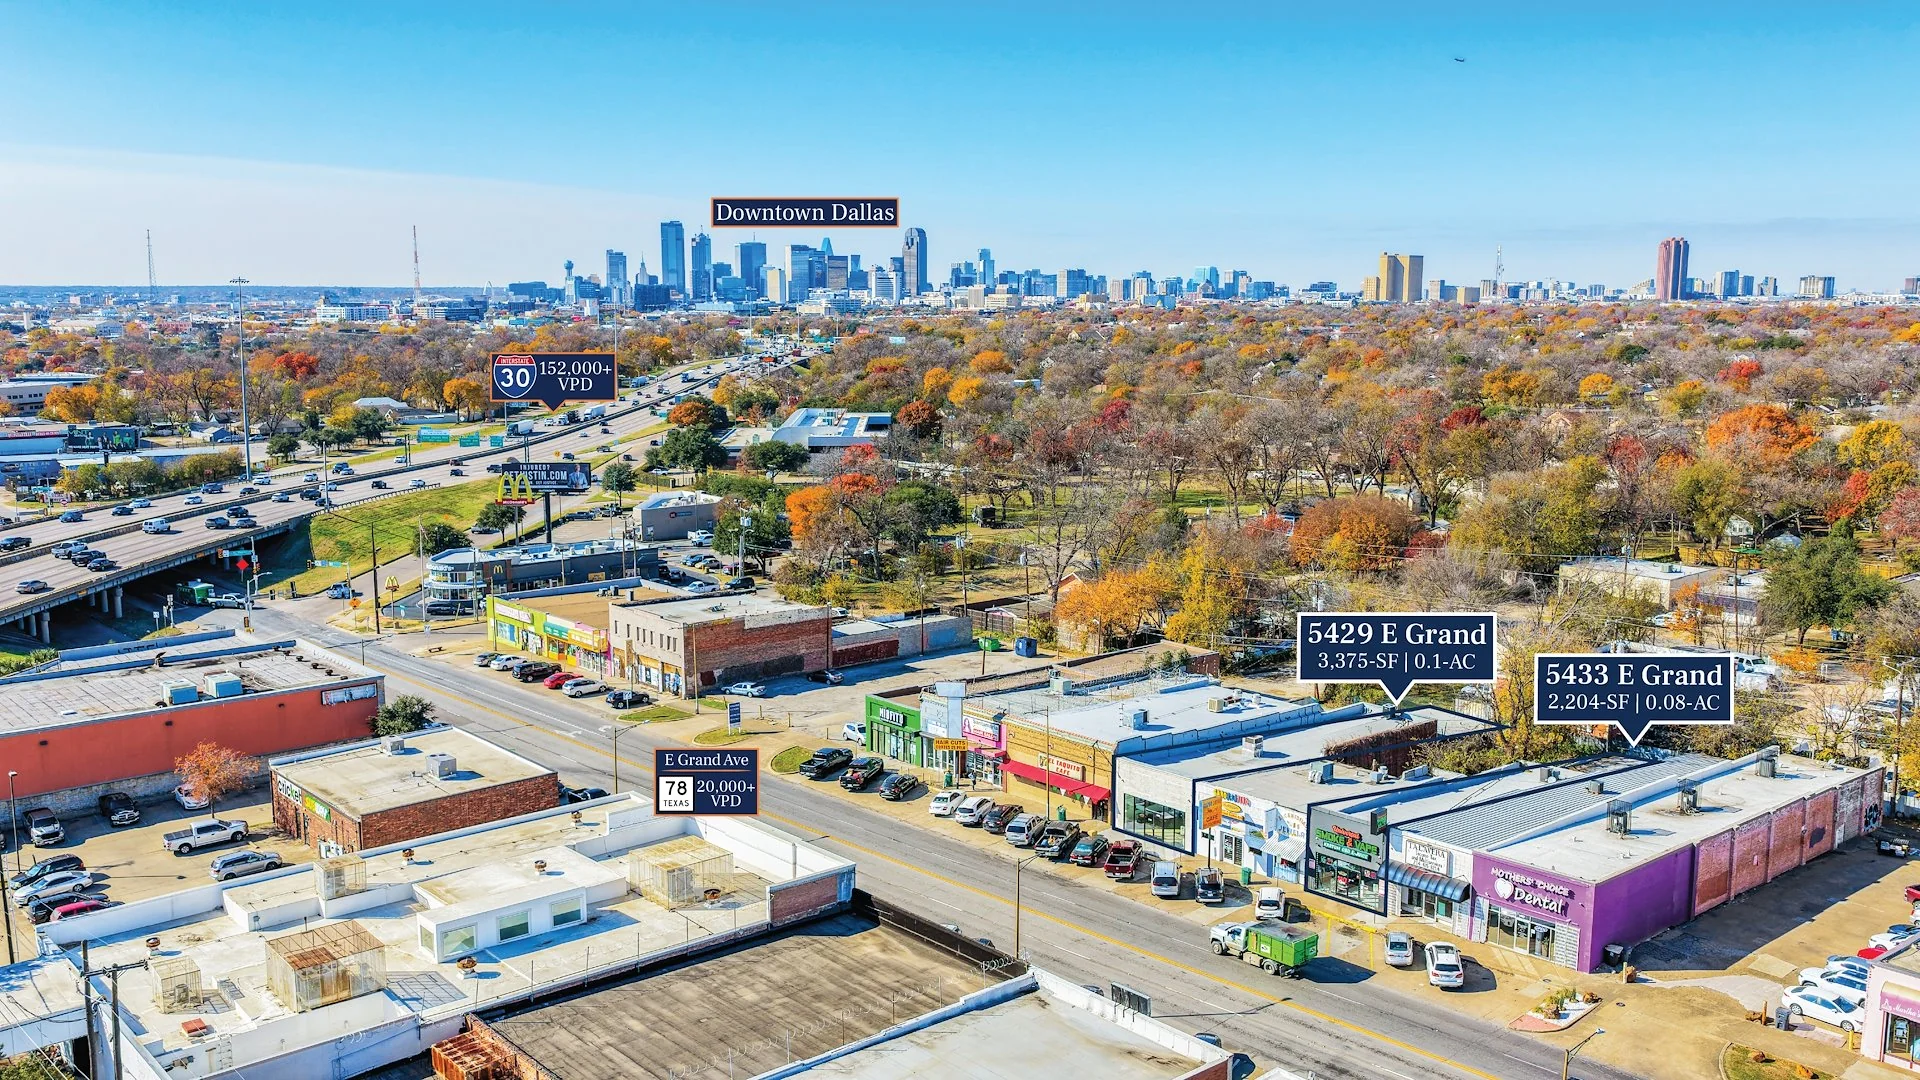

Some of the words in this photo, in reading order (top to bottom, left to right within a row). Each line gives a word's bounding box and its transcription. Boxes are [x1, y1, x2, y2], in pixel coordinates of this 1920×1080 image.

[1056, 760, 1081, 772] TAQUITO
[278, 780, 302, 804] cricket
[1315, 829, 1345, 846] SMOKE
[1354, 840, 1378, 856] VAPE
[1409, 842, 1445, 858] TALAVERA
[1535, 880, 1570, 897] CHOICE
[1514, 888, 1563, 914] Dental
